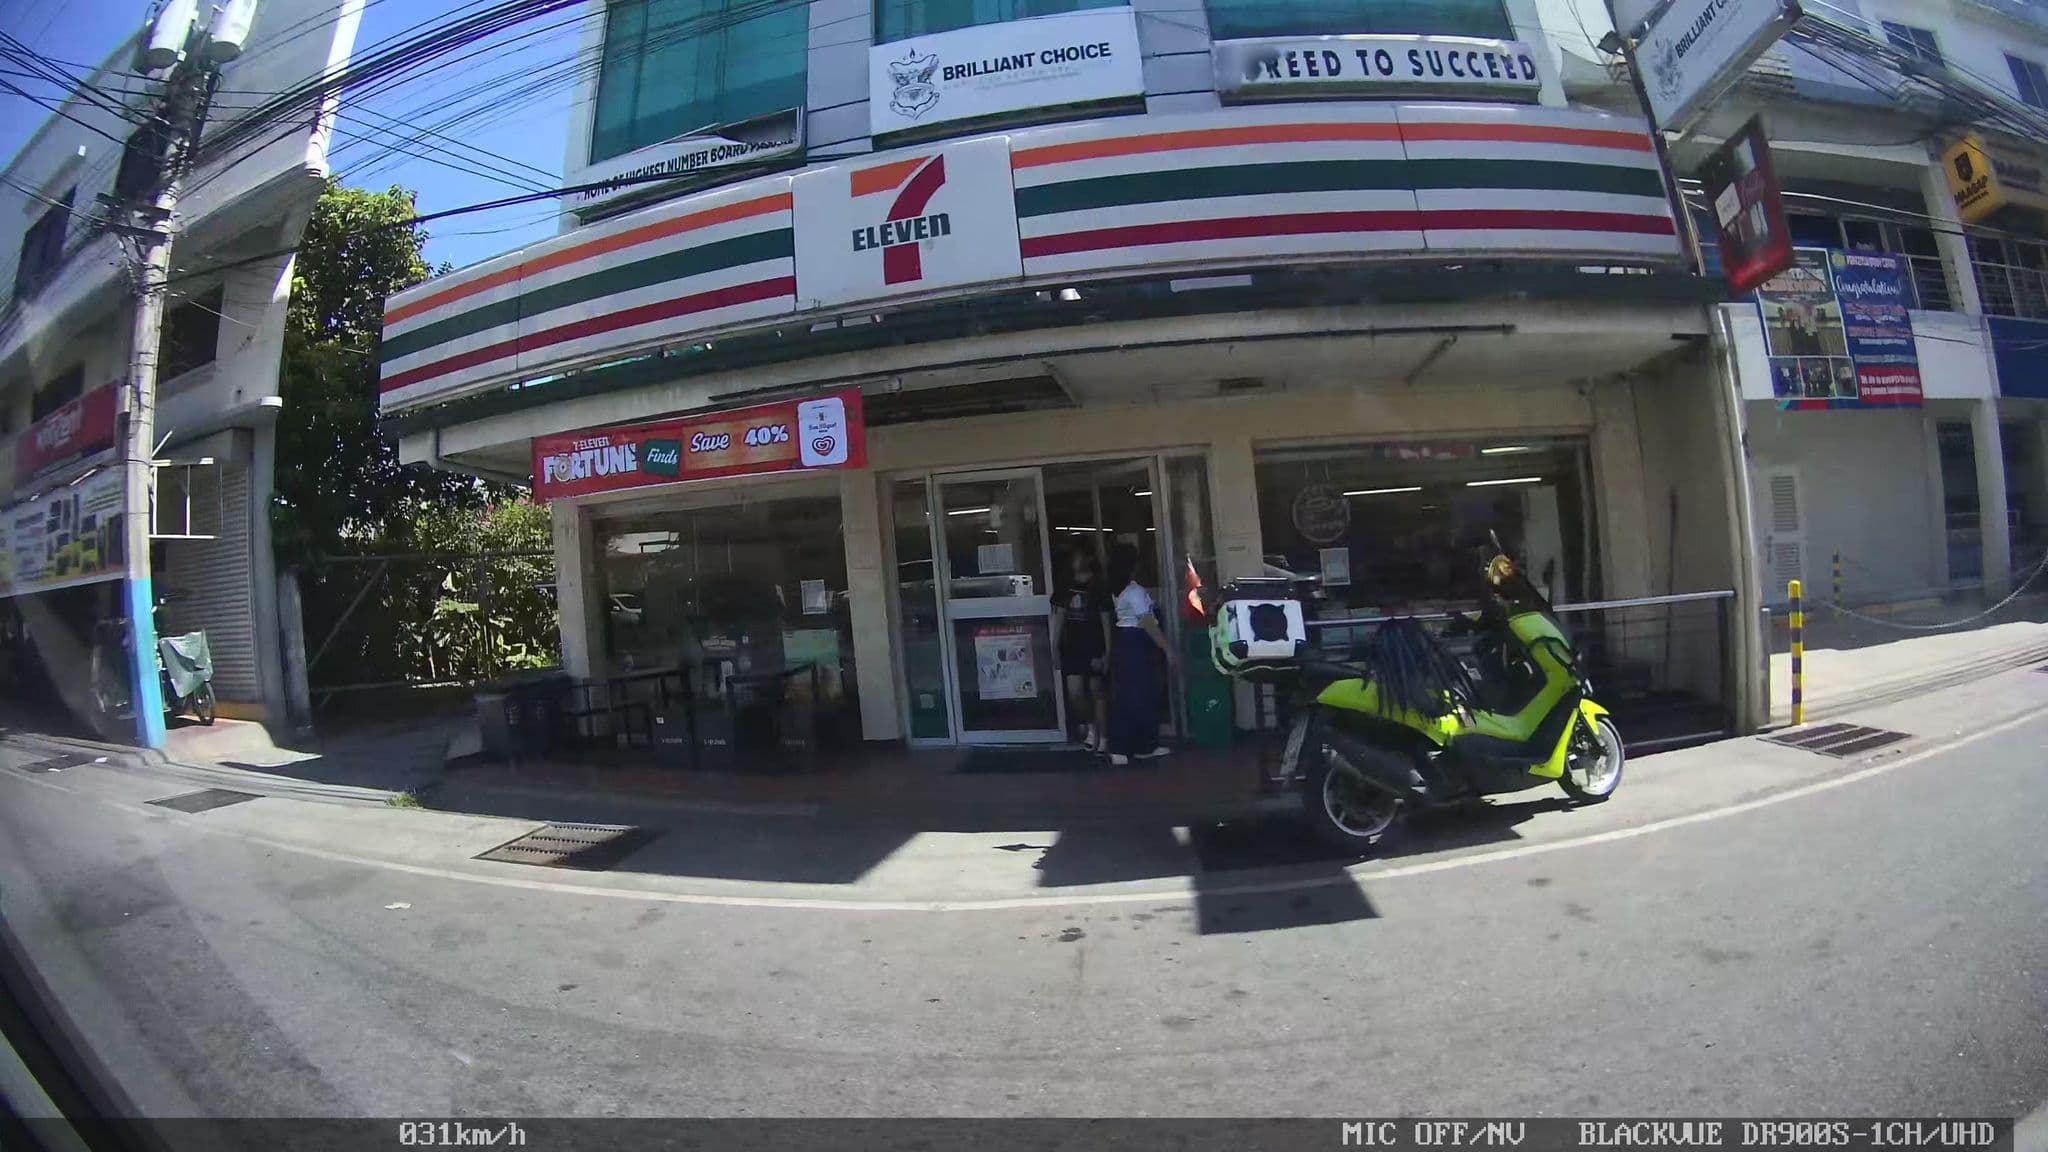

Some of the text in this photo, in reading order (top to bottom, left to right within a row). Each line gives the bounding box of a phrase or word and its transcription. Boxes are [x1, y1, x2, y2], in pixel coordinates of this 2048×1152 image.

[1675, 1, 1716, 58] BRILLIANT
[942, 52, 1036, 81] BRILLIANT
[1040, 42, 1112, 64] CHOICE
[1356, 49, 1394, 76] TO
[1407, 49, 1536, 81] SUCCEED
[667, 150, 708, 175] NUMBER
[710, 144, 748, 163] BOARD
[851, 153, 946, 285] 7
[690, 424, 789, 453] Save 40%
[543, 442, 678, 484] FORTUNE Finds
